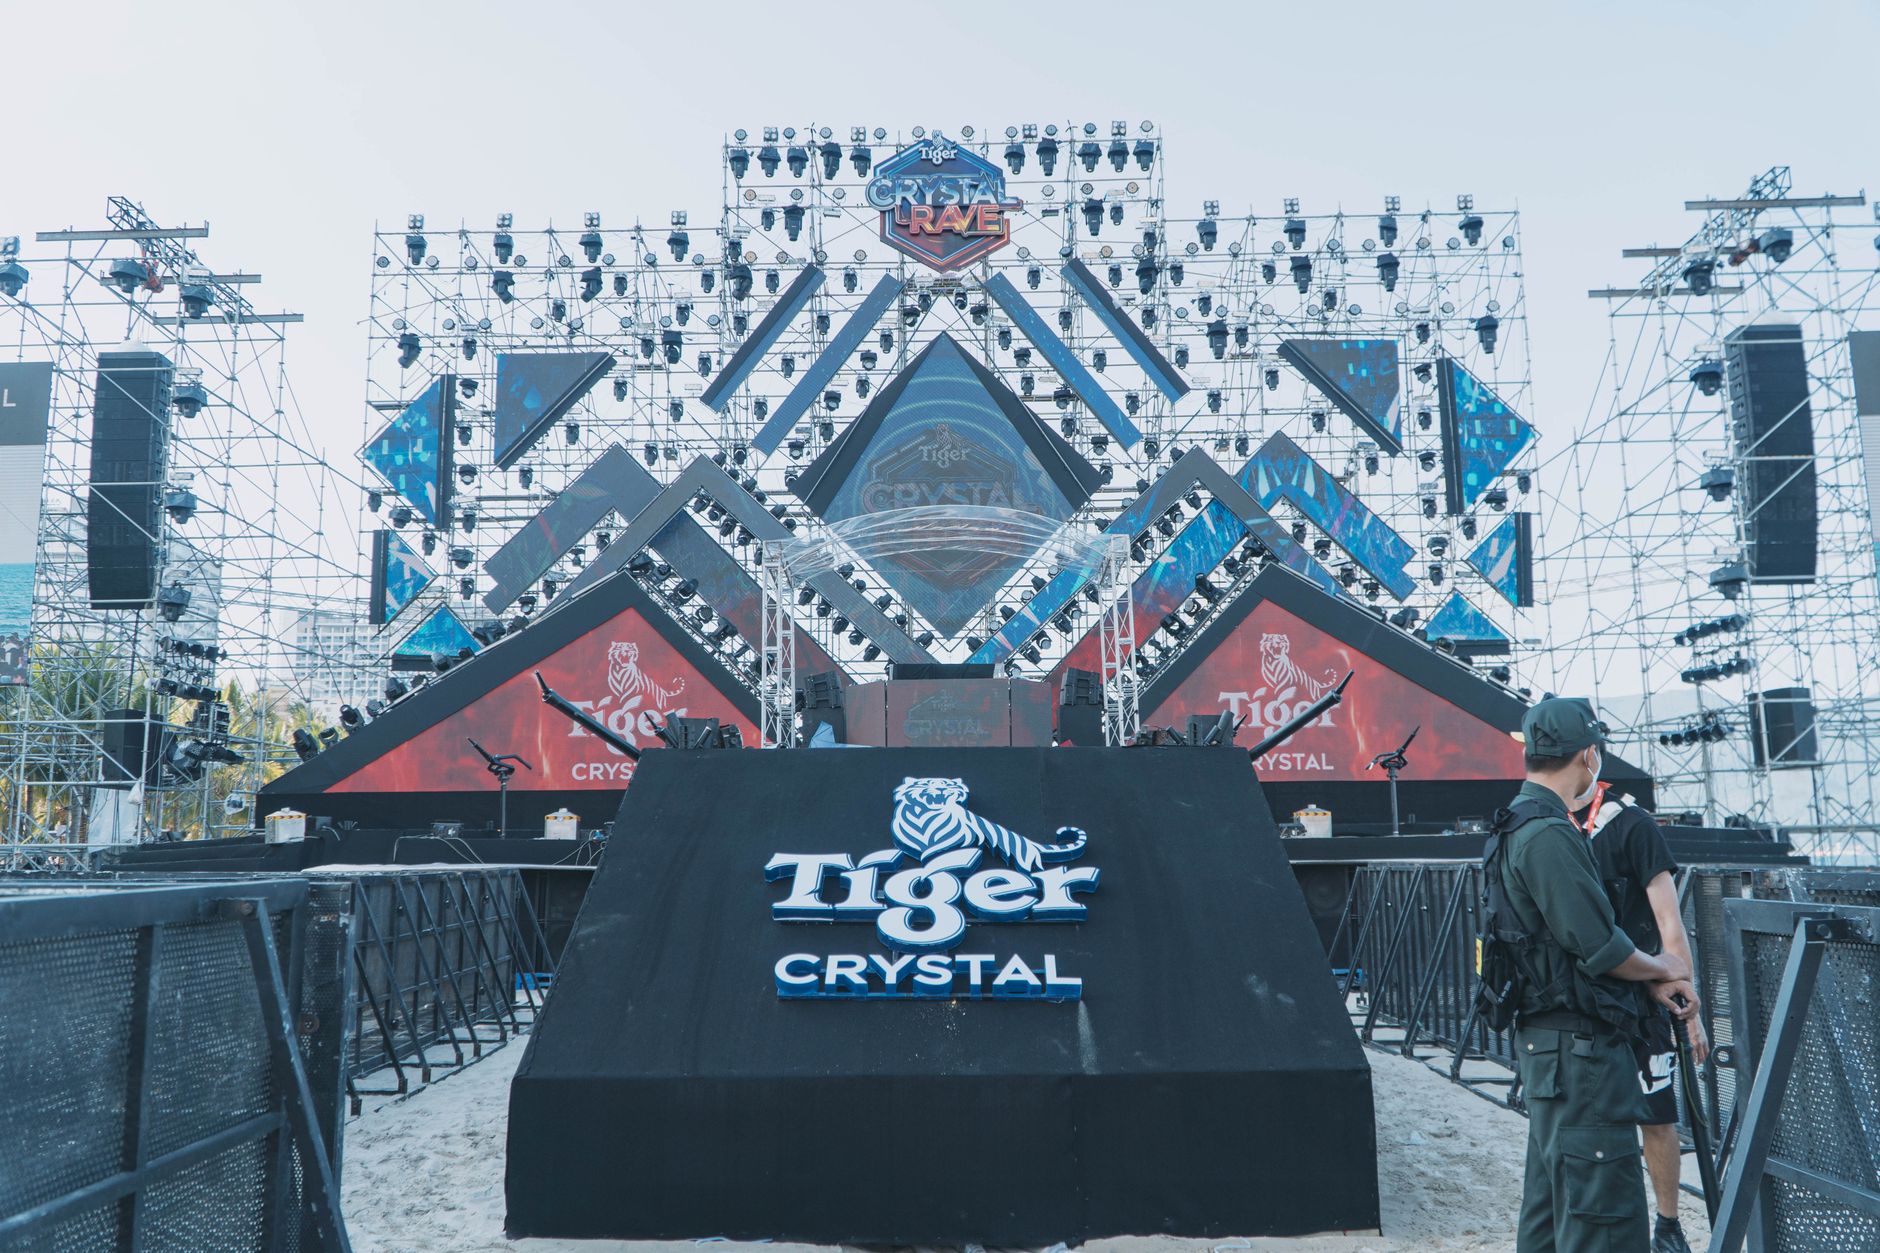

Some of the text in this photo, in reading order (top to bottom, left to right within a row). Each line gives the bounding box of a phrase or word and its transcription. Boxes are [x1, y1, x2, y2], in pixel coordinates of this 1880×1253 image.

[919, 146, 958, 165] Tiger
[867, 173, 1022, 208] CRYSTAL
[909, 204, 1004, 236] RAVE
[919, 445, 970, 468] Tiger
[862, 478, 1042, 514] CRYSTAL
[571, 763, 638, 780] CRYS
[1252, 753, 1335, 770] RYSTAL
[764, 848, 1100, 951] Tiger
[774, 953, 1082, 994] CRYSTAL
